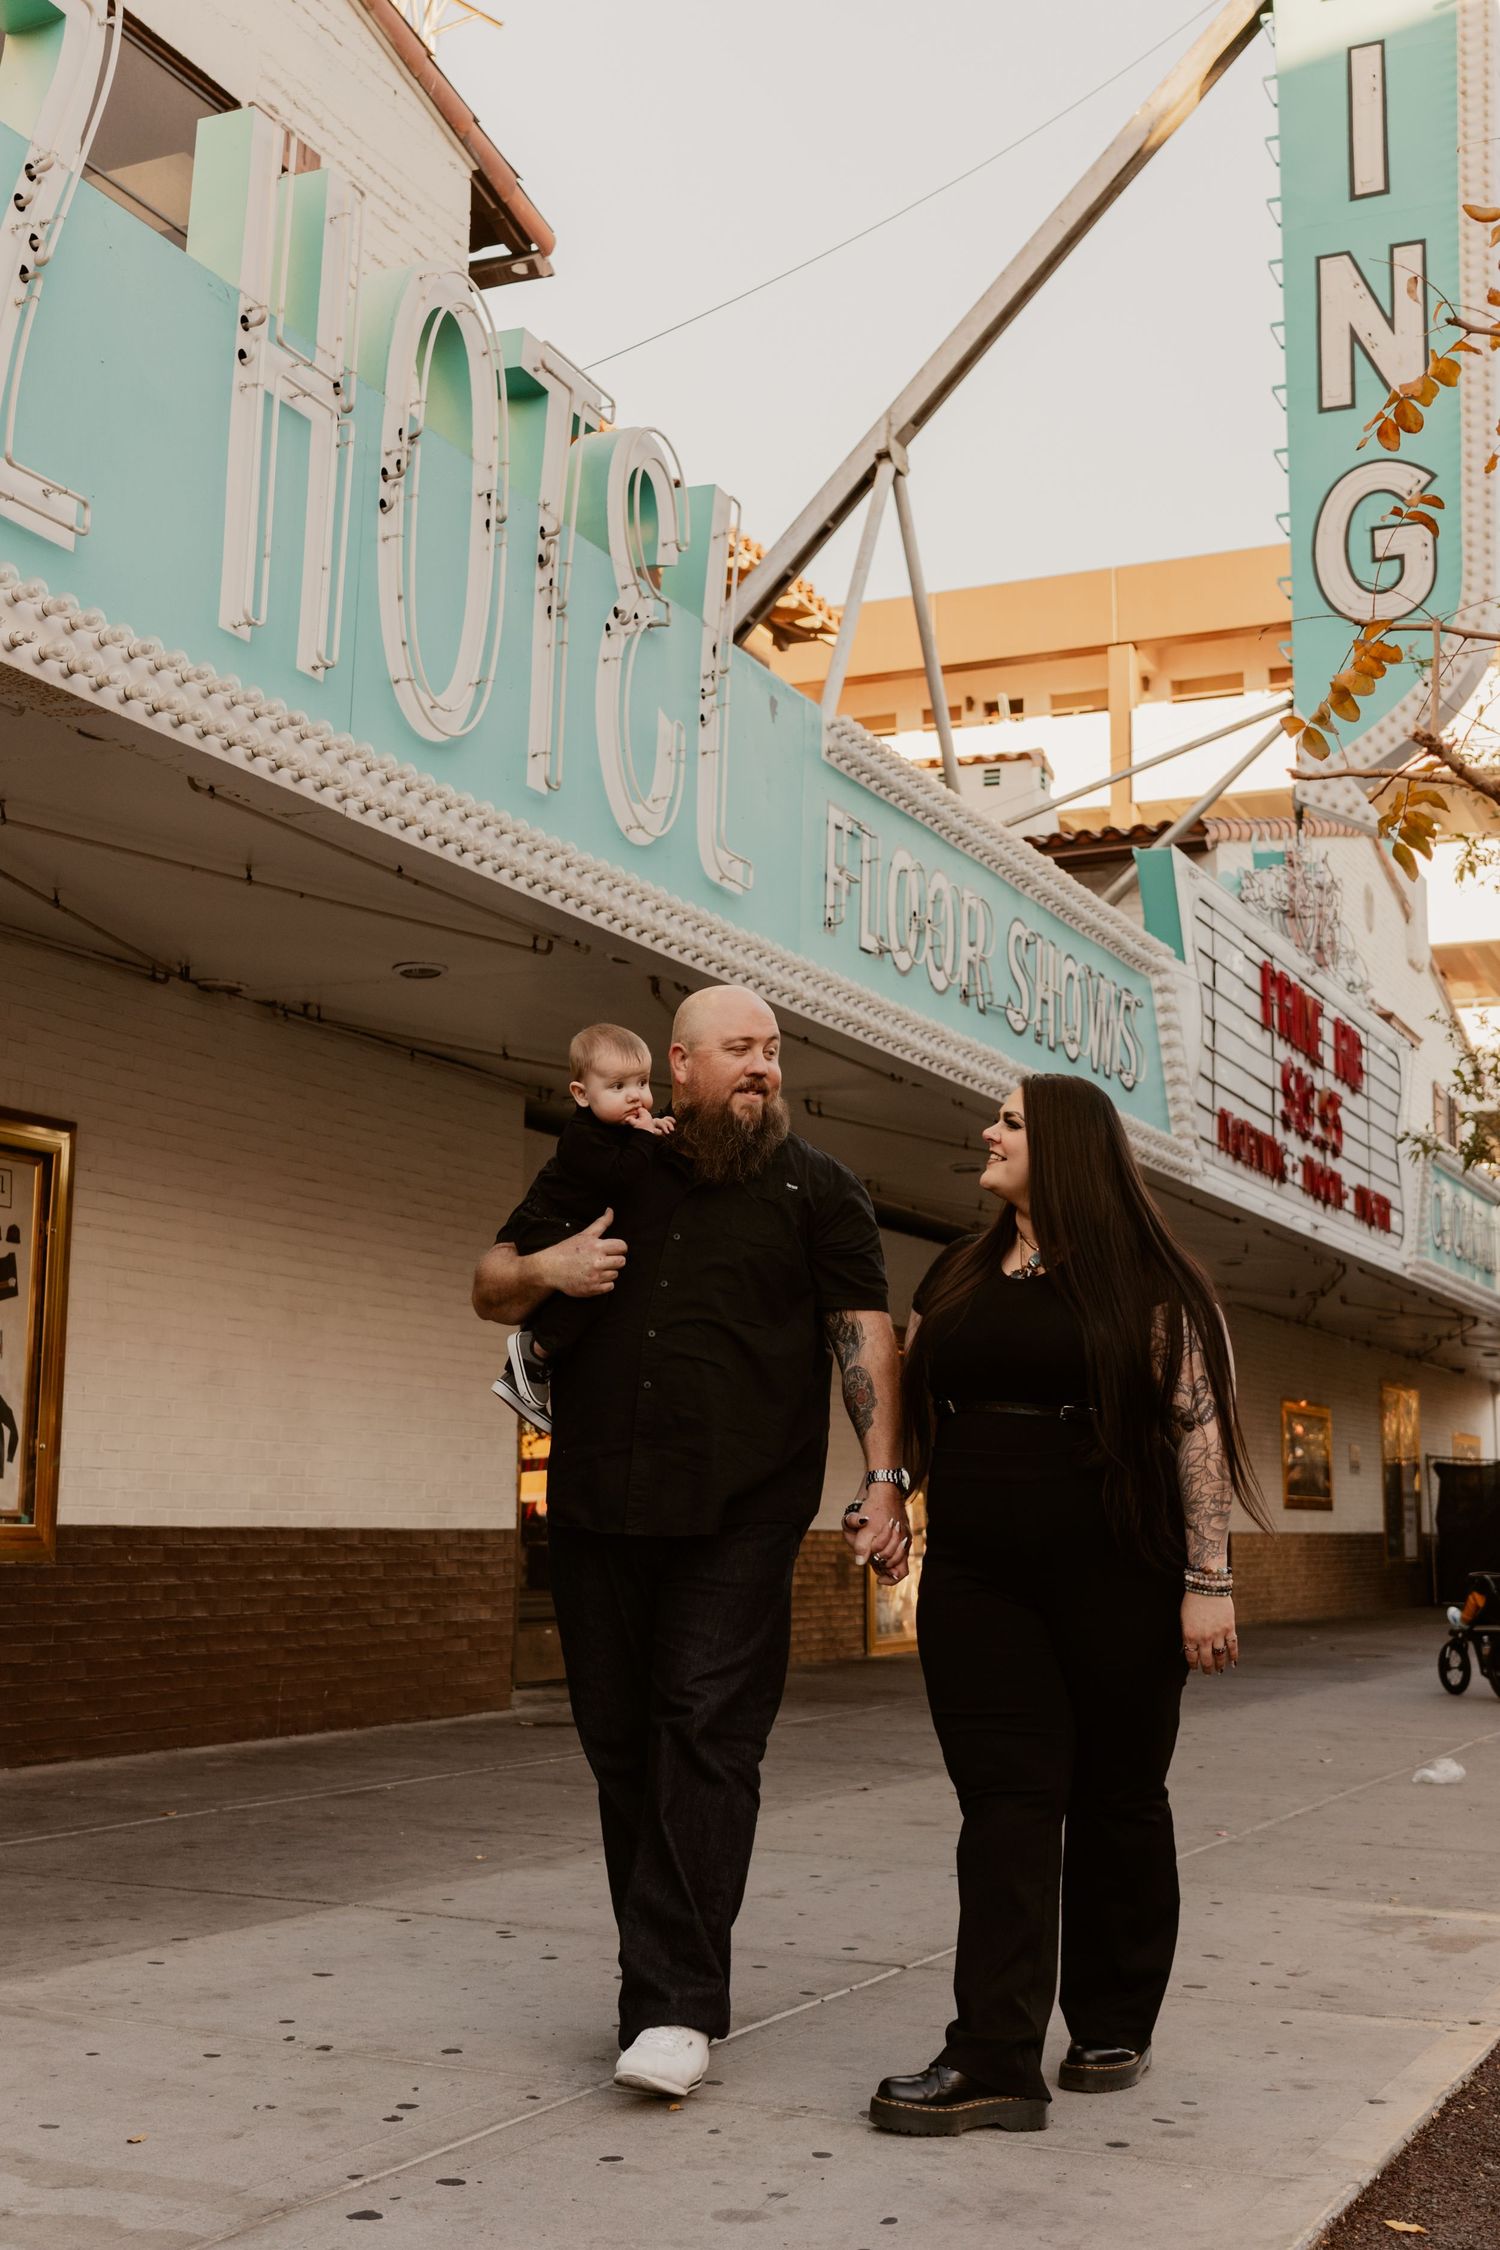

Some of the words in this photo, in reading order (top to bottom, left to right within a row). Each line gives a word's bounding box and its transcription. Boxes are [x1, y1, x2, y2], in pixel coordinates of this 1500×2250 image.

[192, 104, 753, 896] HOTEL
[1313, 38, 1440, 624] ING
[824, 800, 996, 1015] FLOOR
[1005, 917, 1147, 1092] SHOWS
